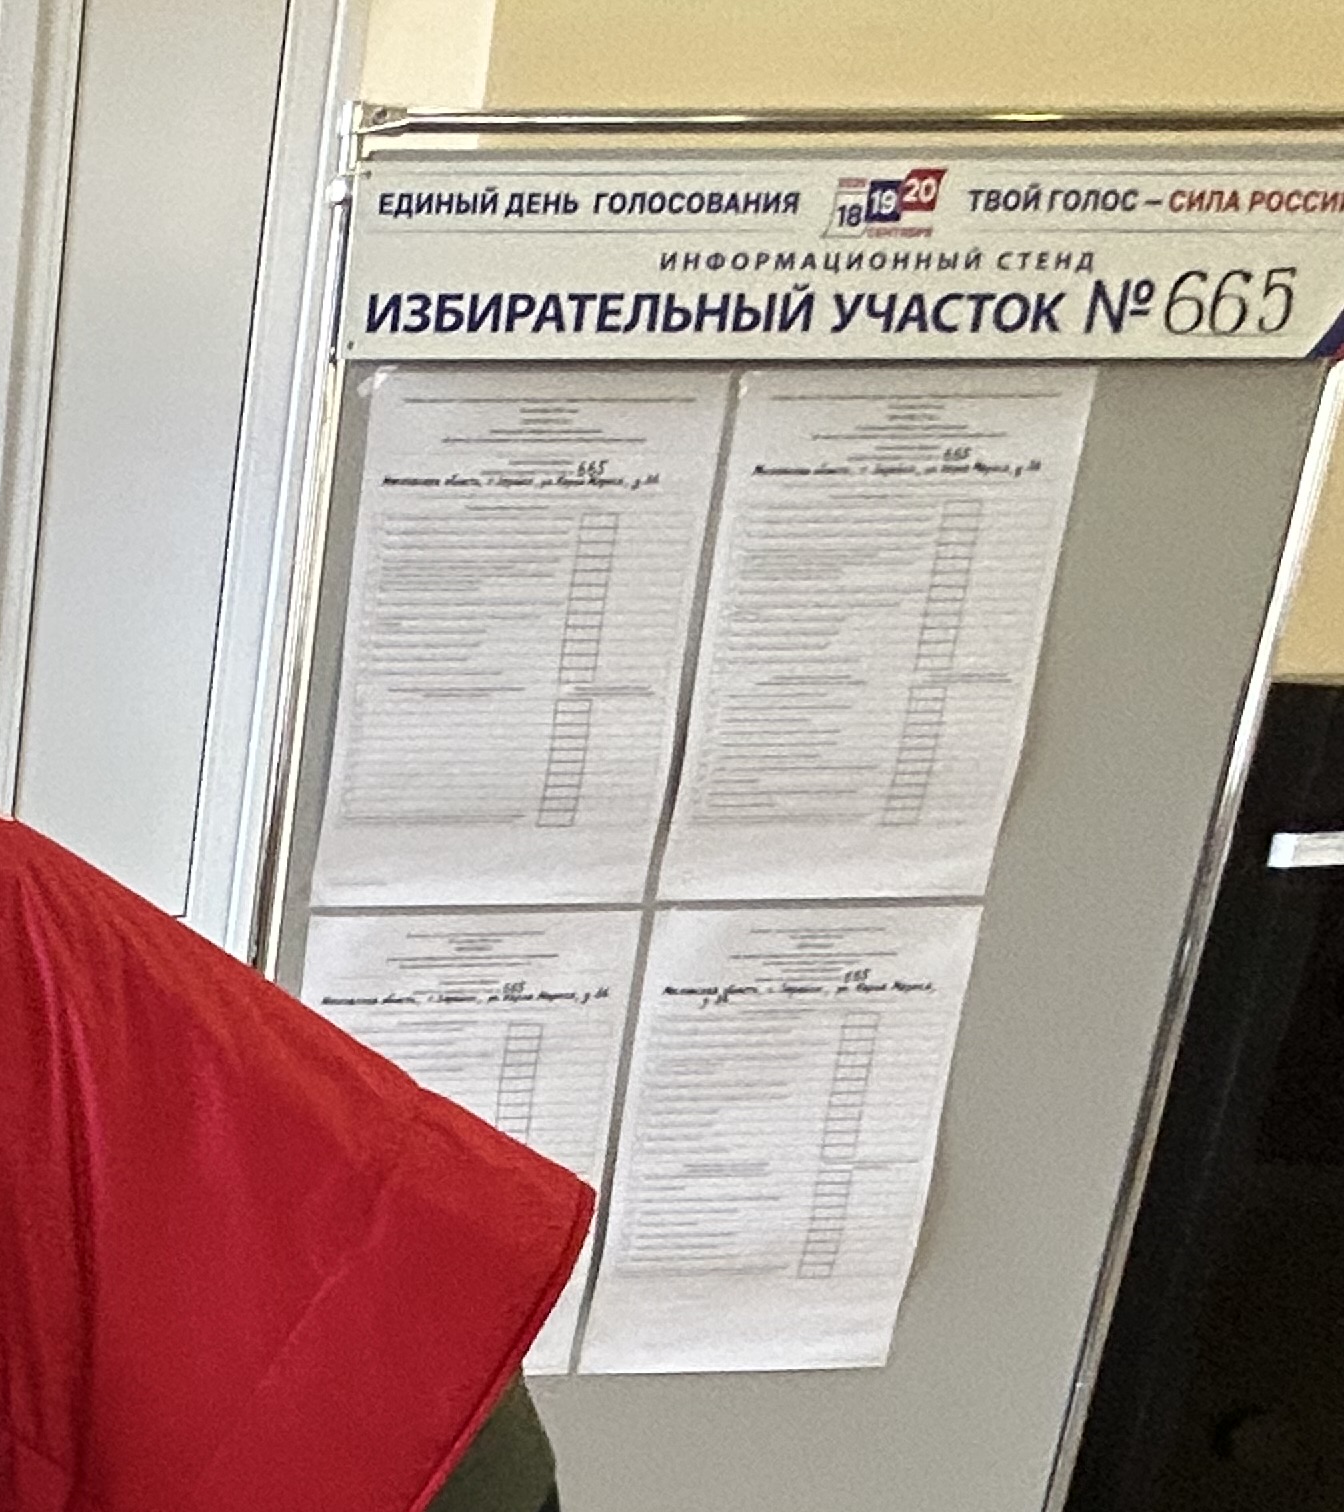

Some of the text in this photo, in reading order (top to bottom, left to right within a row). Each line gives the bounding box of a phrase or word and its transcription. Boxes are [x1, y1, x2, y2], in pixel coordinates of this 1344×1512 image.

[378, 187, 801, 218] ЕДИНЫЙ ДЕНЬ ГОЛОСОВАНИЯ
[837, 178, 937, 227] 18 19 20
[968, 182, 1043, 212] ТВОЙ
[1047, 188, 1140, 213] ГОЛОС
[1169, 188, 1240, 213] СИЛА
[1248, 188, 1344, 213] РОССИ
[659, 249, 1096, 274] ИНФОРМАЦИОННЫЙ СТЕНД
[365, 285, 815, 334] ИЗБИРАТЕЛЬНЫЙ
[830, 292, 1066, 334] УЧАСТОК
[1163, 267, 1299, 335] 665
